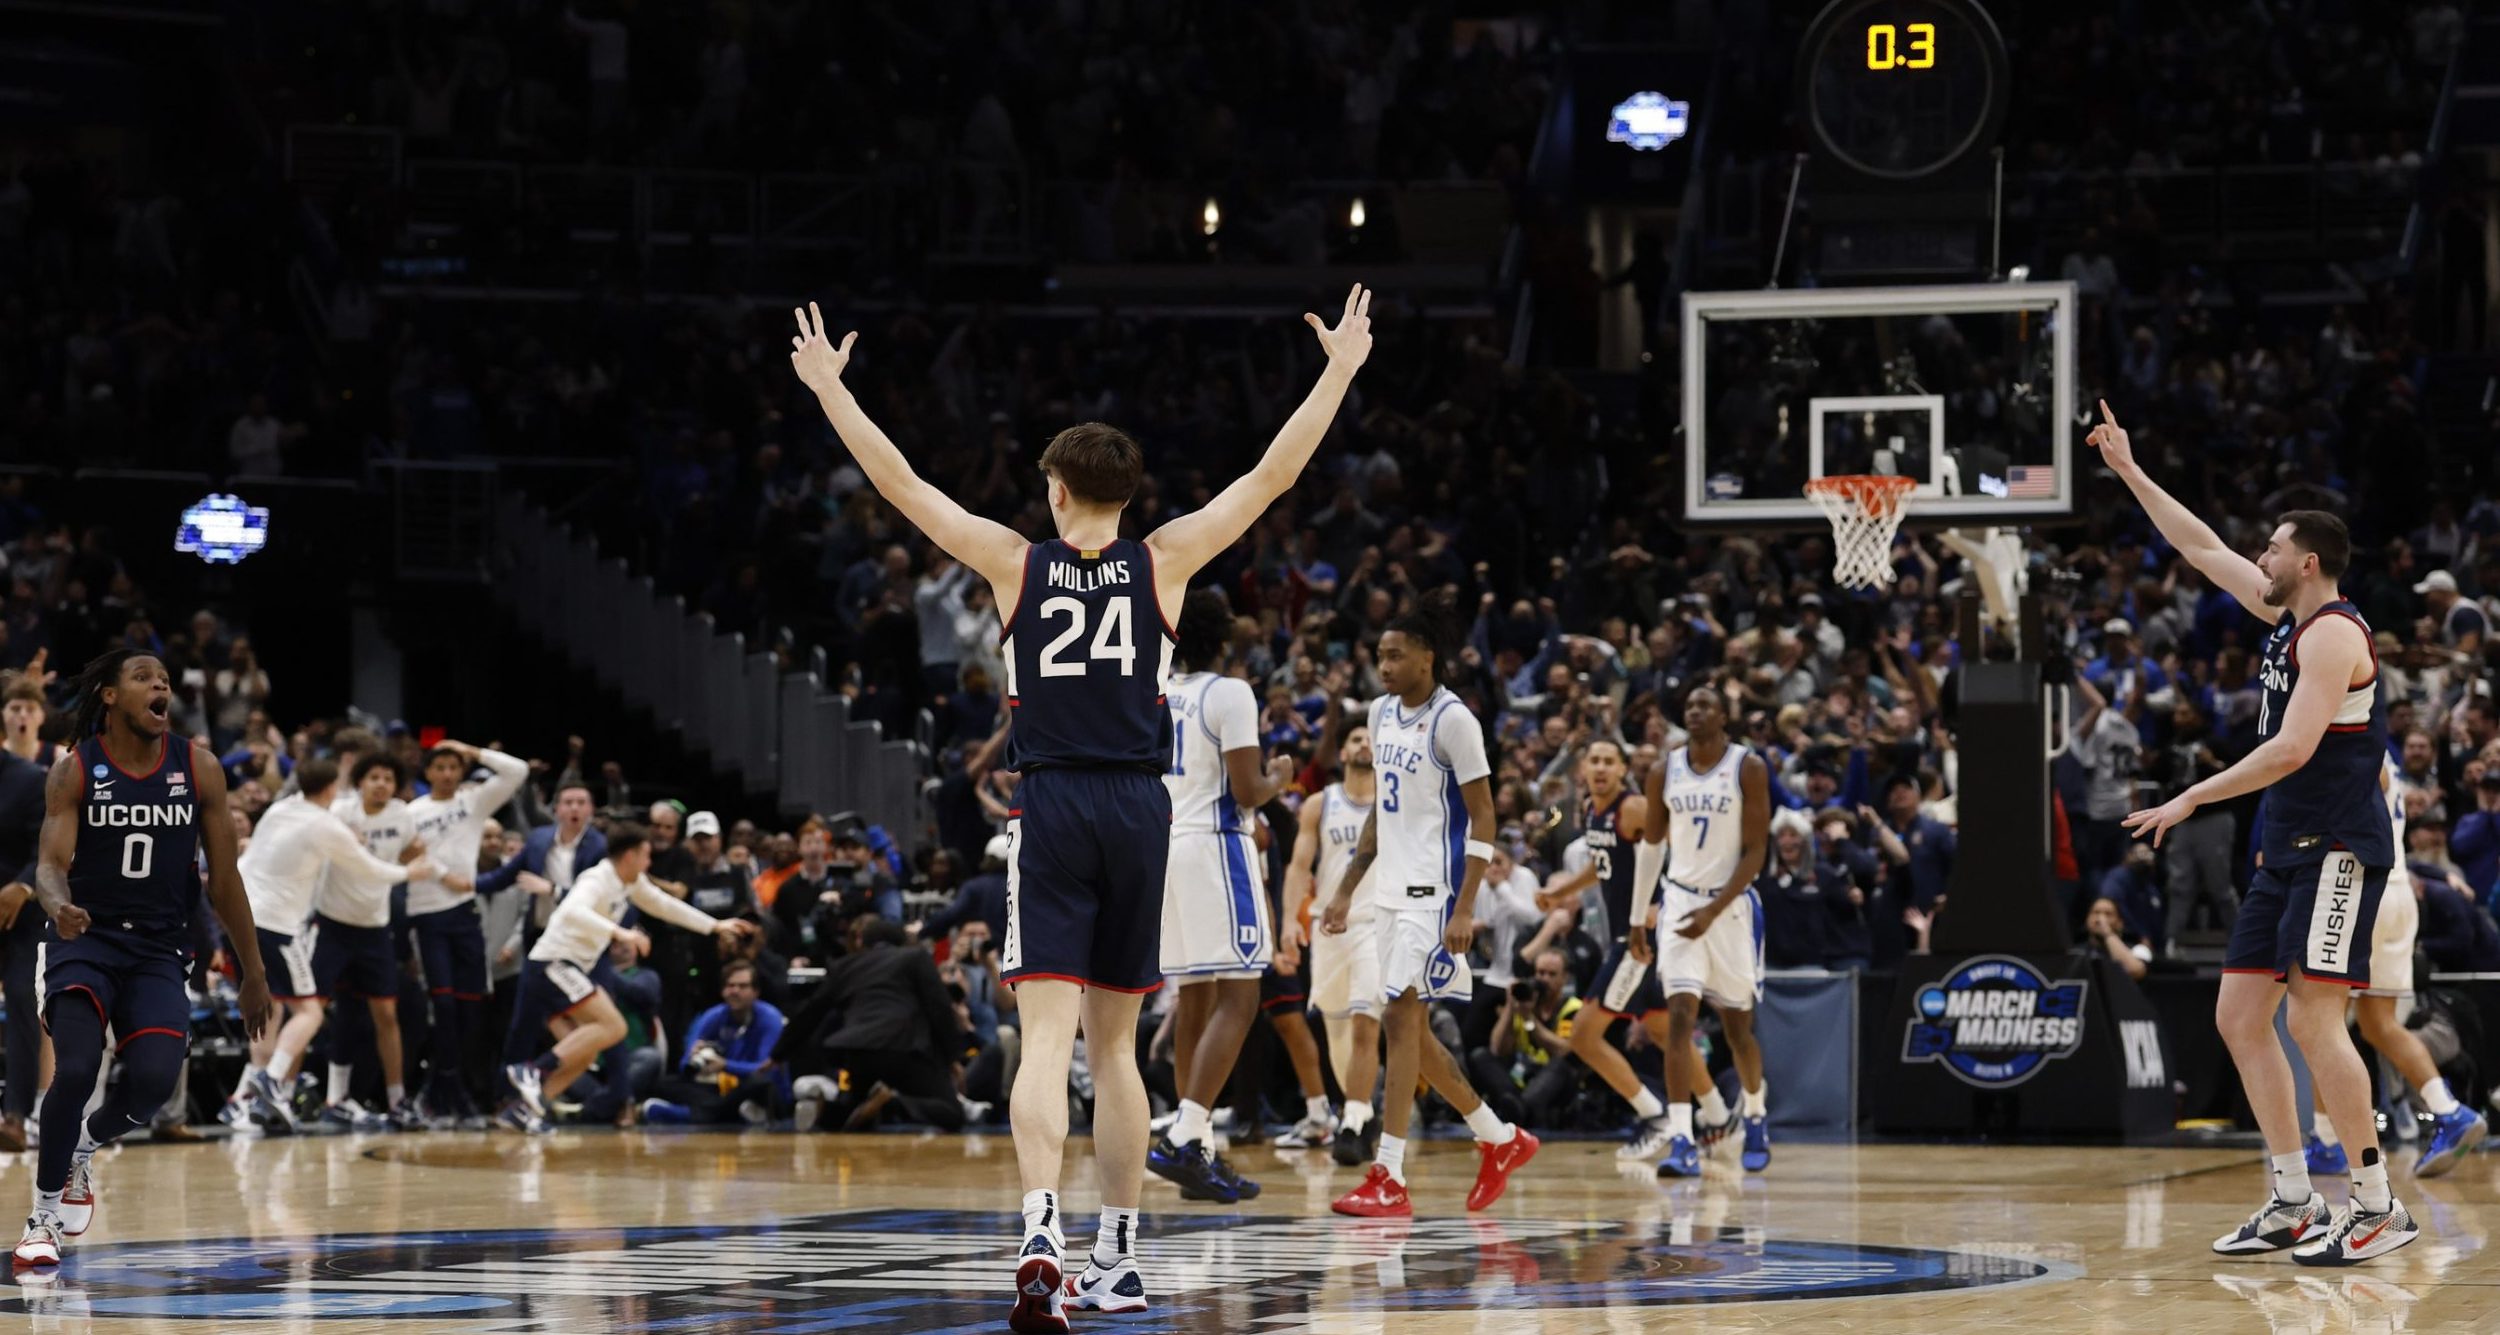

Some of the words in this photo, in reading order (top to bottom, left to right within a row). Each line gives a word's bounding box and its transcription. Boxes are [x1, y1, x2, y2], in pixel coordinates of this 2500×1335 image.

[1867, 24, 1935, 69] 0.3
[1048, 560, 1131, 592] MULLINS
[1039, 596, 1137, 677] 24
[1168, 719, 1185, 775] 1
[1382, 771, 1399, 813] 3
[1670, 794, 1732, 814] DUKE
[87, 803, 194, 827] UCONN
[1329, 825, 1357, 845] DU
[1692, 816, 1709, 850] 7
[121, 832, 154, 879] 0
[2320, 858, 2356, 966] HUSKIES
[1945, 989, 2038, 1018] MARCH
[1955, 1017, 2078, 1046] MADNESS
